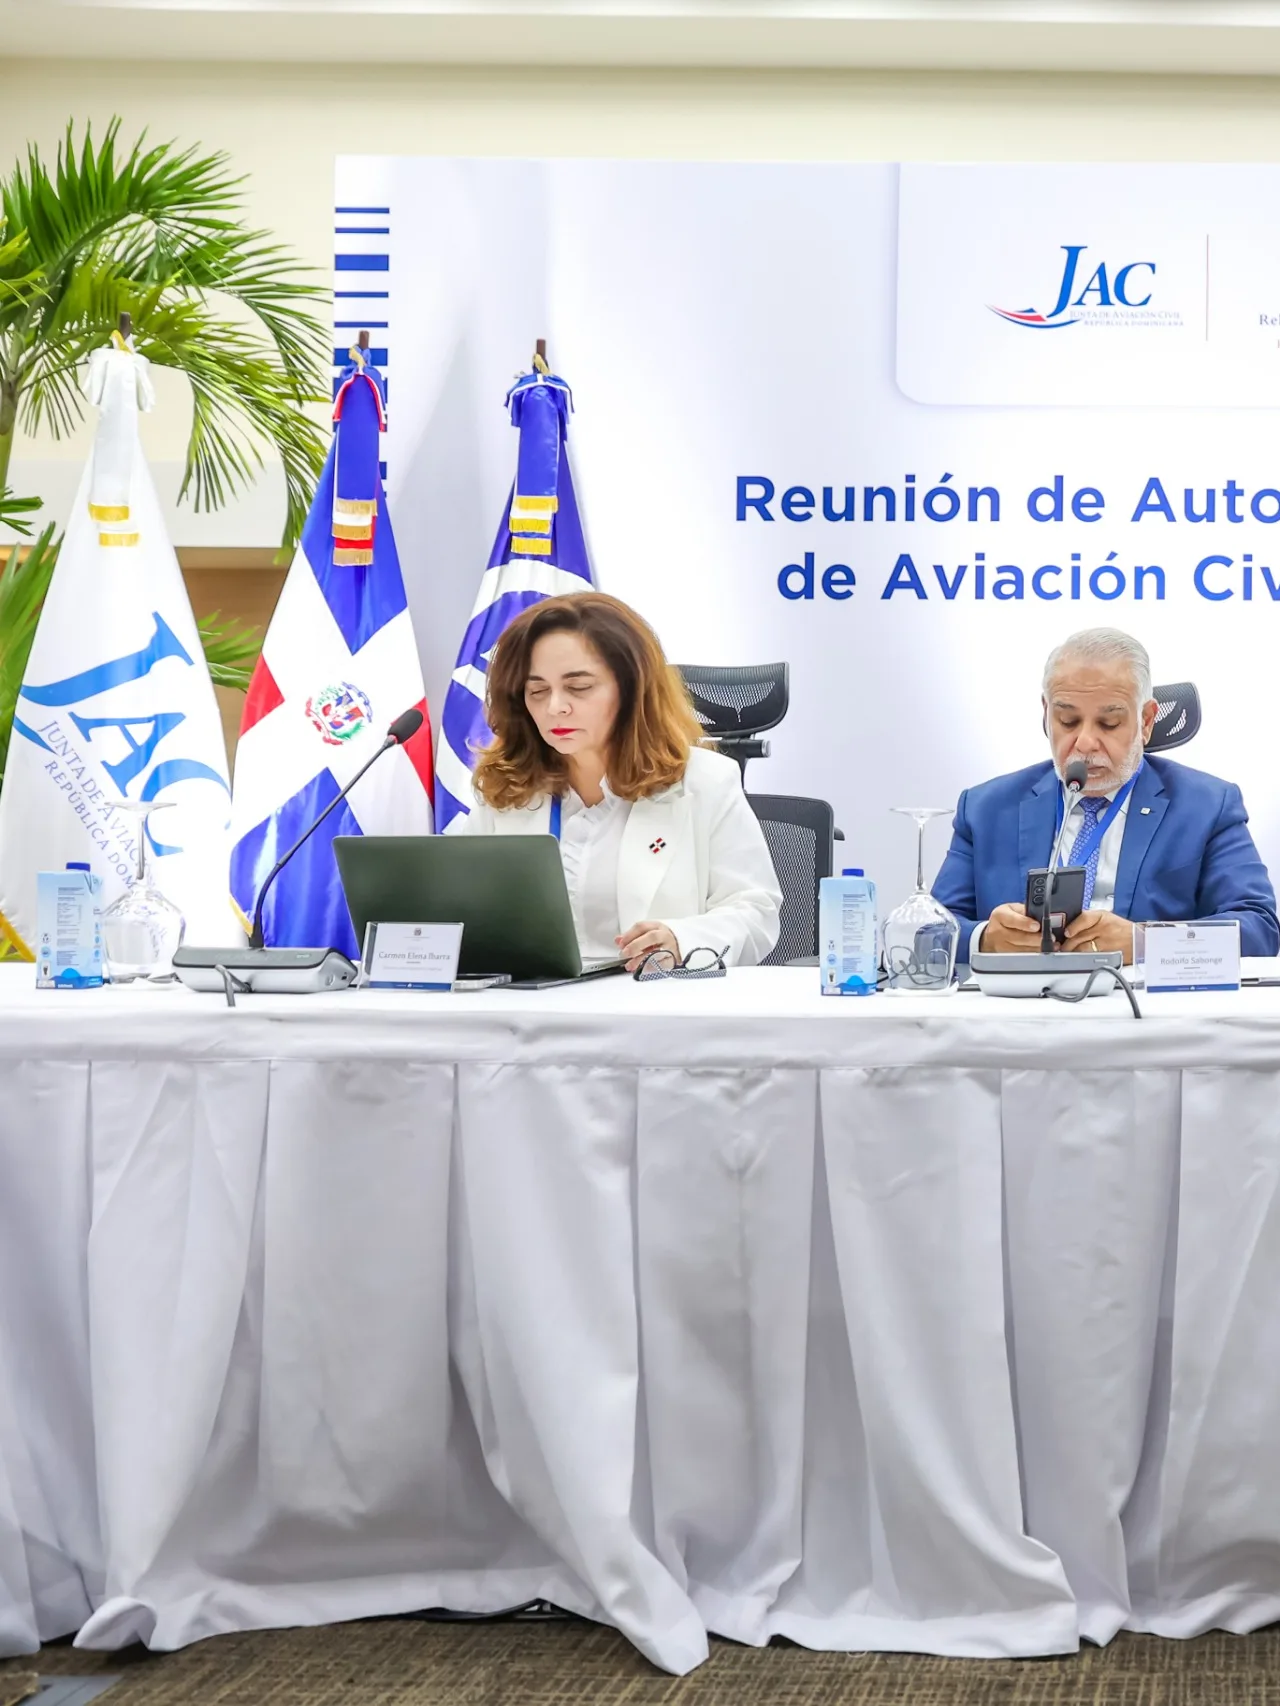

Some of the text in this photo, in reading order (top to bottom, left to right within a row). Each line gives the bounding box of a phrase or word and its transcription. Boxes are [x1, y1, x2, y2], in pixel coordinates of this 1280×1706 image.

[1046, 245, 1156, 319] JAC
[735, 473, 1000, 523] Reunión
[1027, 474, 1105, 523] de
[777, 551, 857, 601] de
[880, 551, 1166, 601] Aviación
[19, 611, 232, 857] JAC
[38, 720, 86, 780] JUNTA
[81, 778, 105, 805] DE
[44, 760, 109, 851] REPÚBLICA
[378, 951, 406, 960] Carmen
[407, 952, 427, 960] Elena
